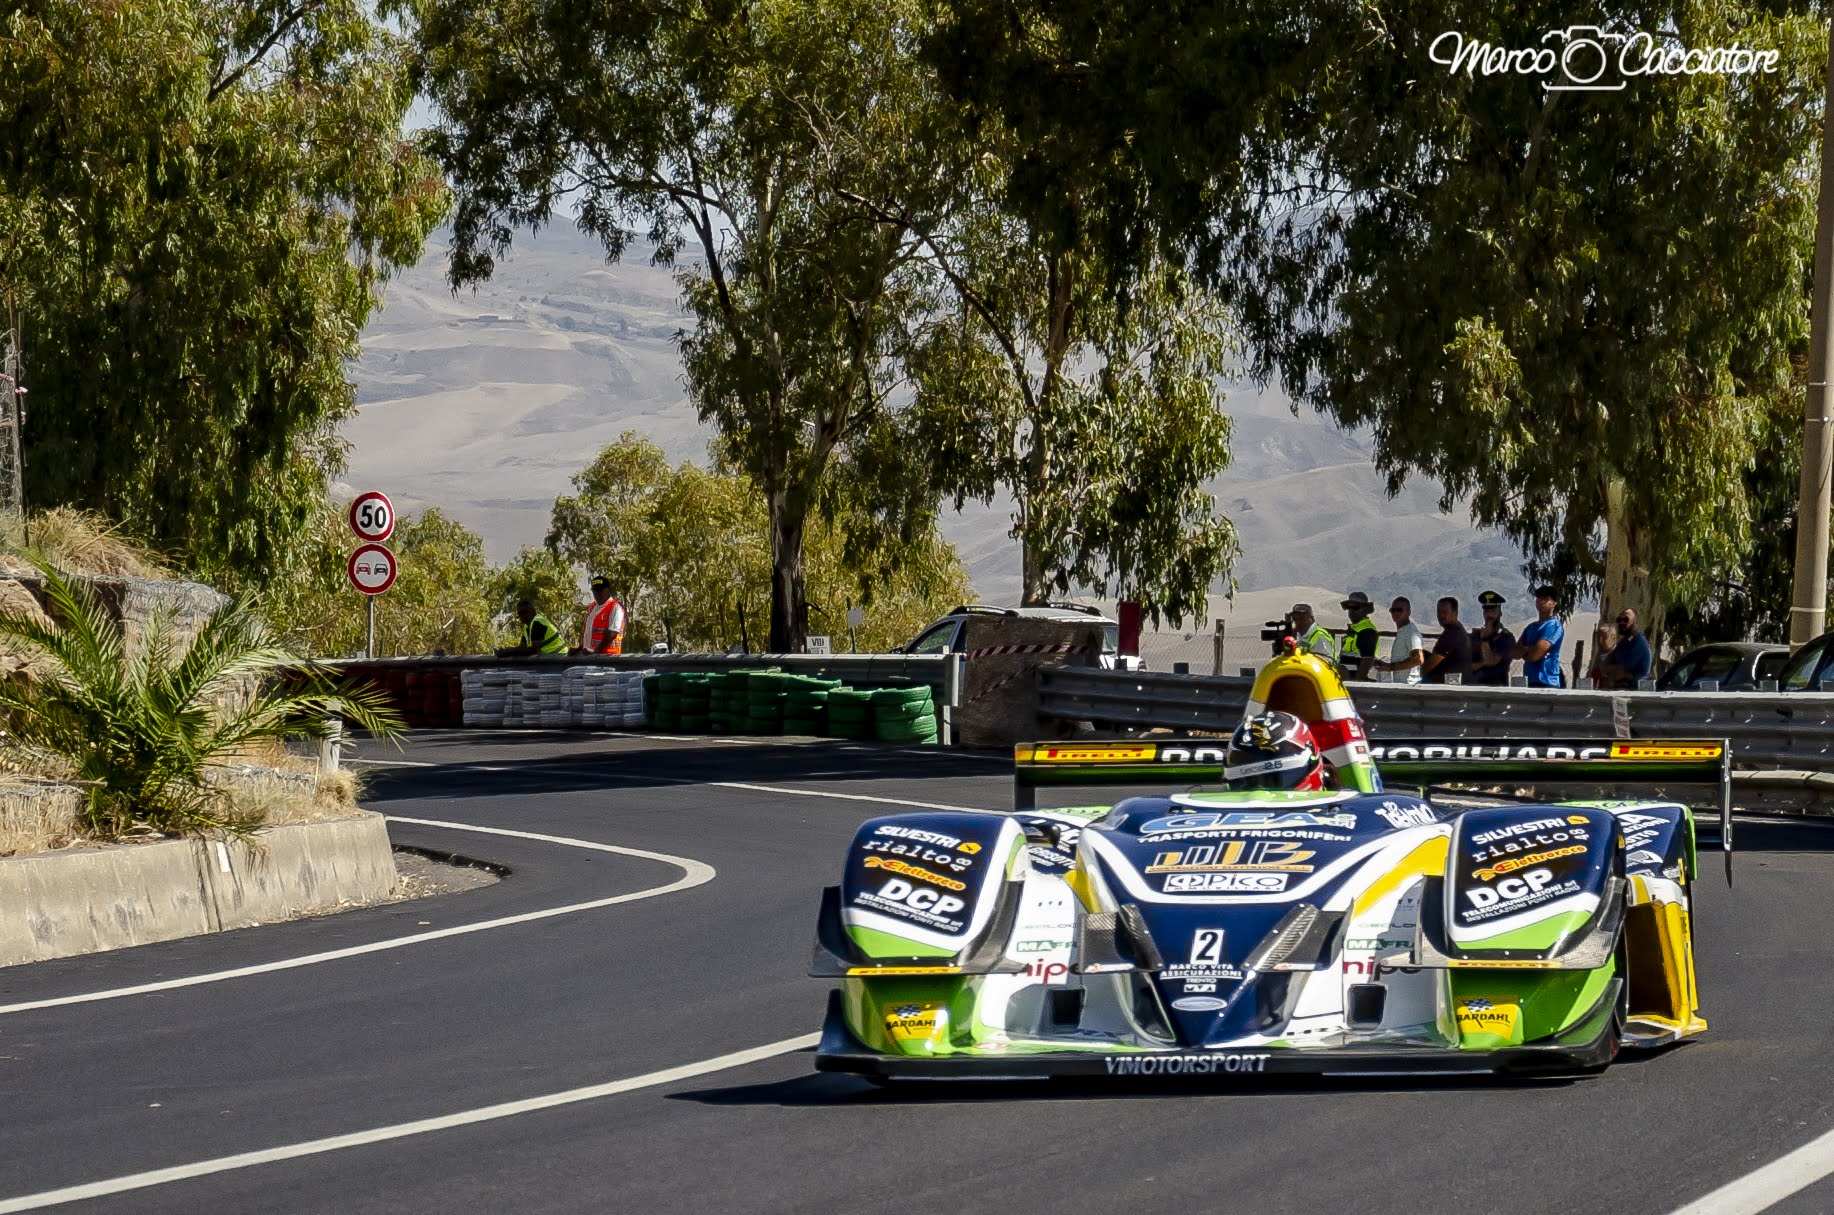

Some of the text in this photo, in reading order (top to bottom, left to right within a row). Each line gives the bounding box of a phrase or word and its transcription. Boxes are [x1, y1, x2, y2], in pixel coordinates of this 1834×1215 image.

[360, 504, 387, 528] 50
[874, 825, 962, 848] SILVESTRI
[1137, 830, 1352, 843] TRASPORTI FRIGORIFERI
[1472, 818, 1567, 845] SILVESTRI
[862, 840, 952, 864] rialto
[1472, 832, 1569, 862] rialto
[877, 878, 965, 915] DCP
[1466, 868, 1553, 909] DCP
[1195, 931, 1219, 961] 2
[1160, 970, 1242, 978] ASSICURAZIONI
[1104, 1053, 1272, 1075] VIMOTORSPORT
